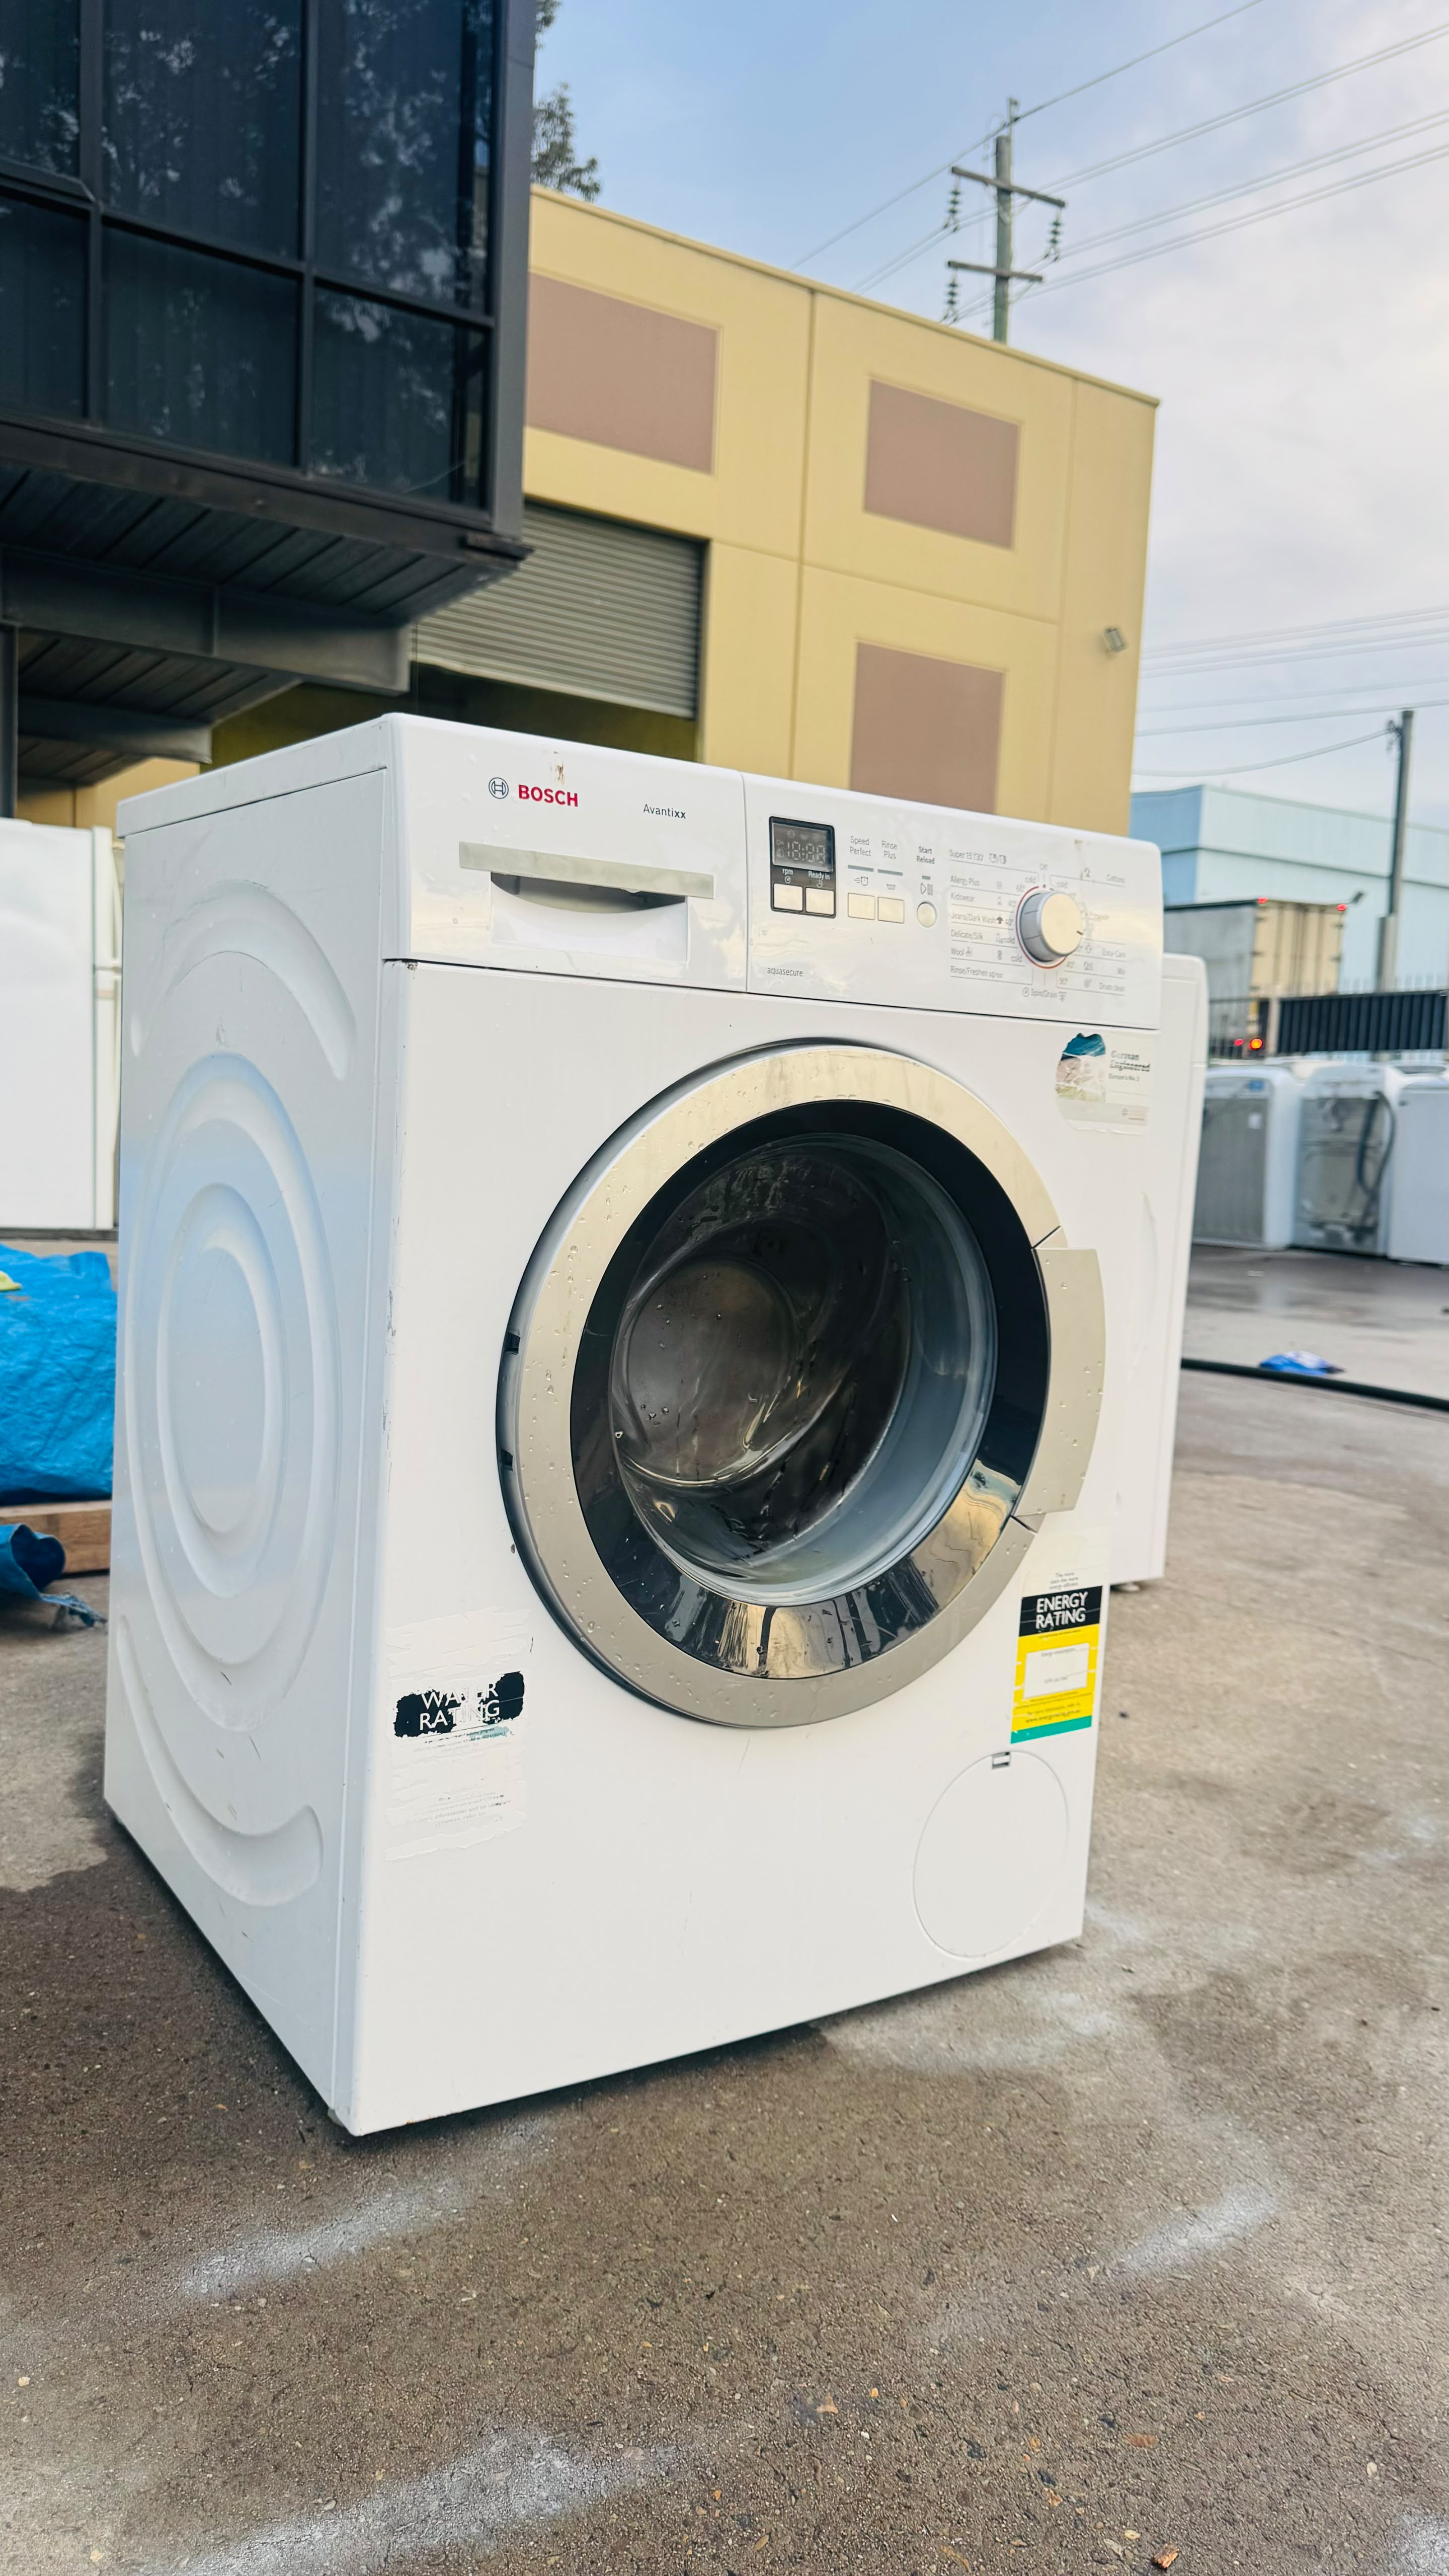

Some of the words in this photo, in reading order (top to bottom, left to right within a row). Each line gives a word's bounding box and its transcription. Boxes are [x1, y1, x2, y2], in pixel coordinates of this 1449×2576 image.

[518, 784, 578, 807] BOSCH
[643, 804, 686, 819] Avantixx
[850, 836, 869, 846] Speed
[881, 841, 897, 850] Rinse
[850, 846, 871, 857] Perfect
[883, 851, 896, 859] Plus
[918, 846, 932, 854] Start
[949, 849, 964, 859] Super
[917, 855, 935, 864] Reload
[809, 871, 824, 880] Ready
[951, 947, 964, 956] Wool
[1011, 954, 1022, 963] cold
[767, 967, 803, 977] aquasecure
[1036, 1591, 1089, 1614] ENERGY
[1035, 1607, 1087, 1630] RATING
[421, 1682, 499, 1710] WATER
[420, 1700, 500, 1731] RATING
